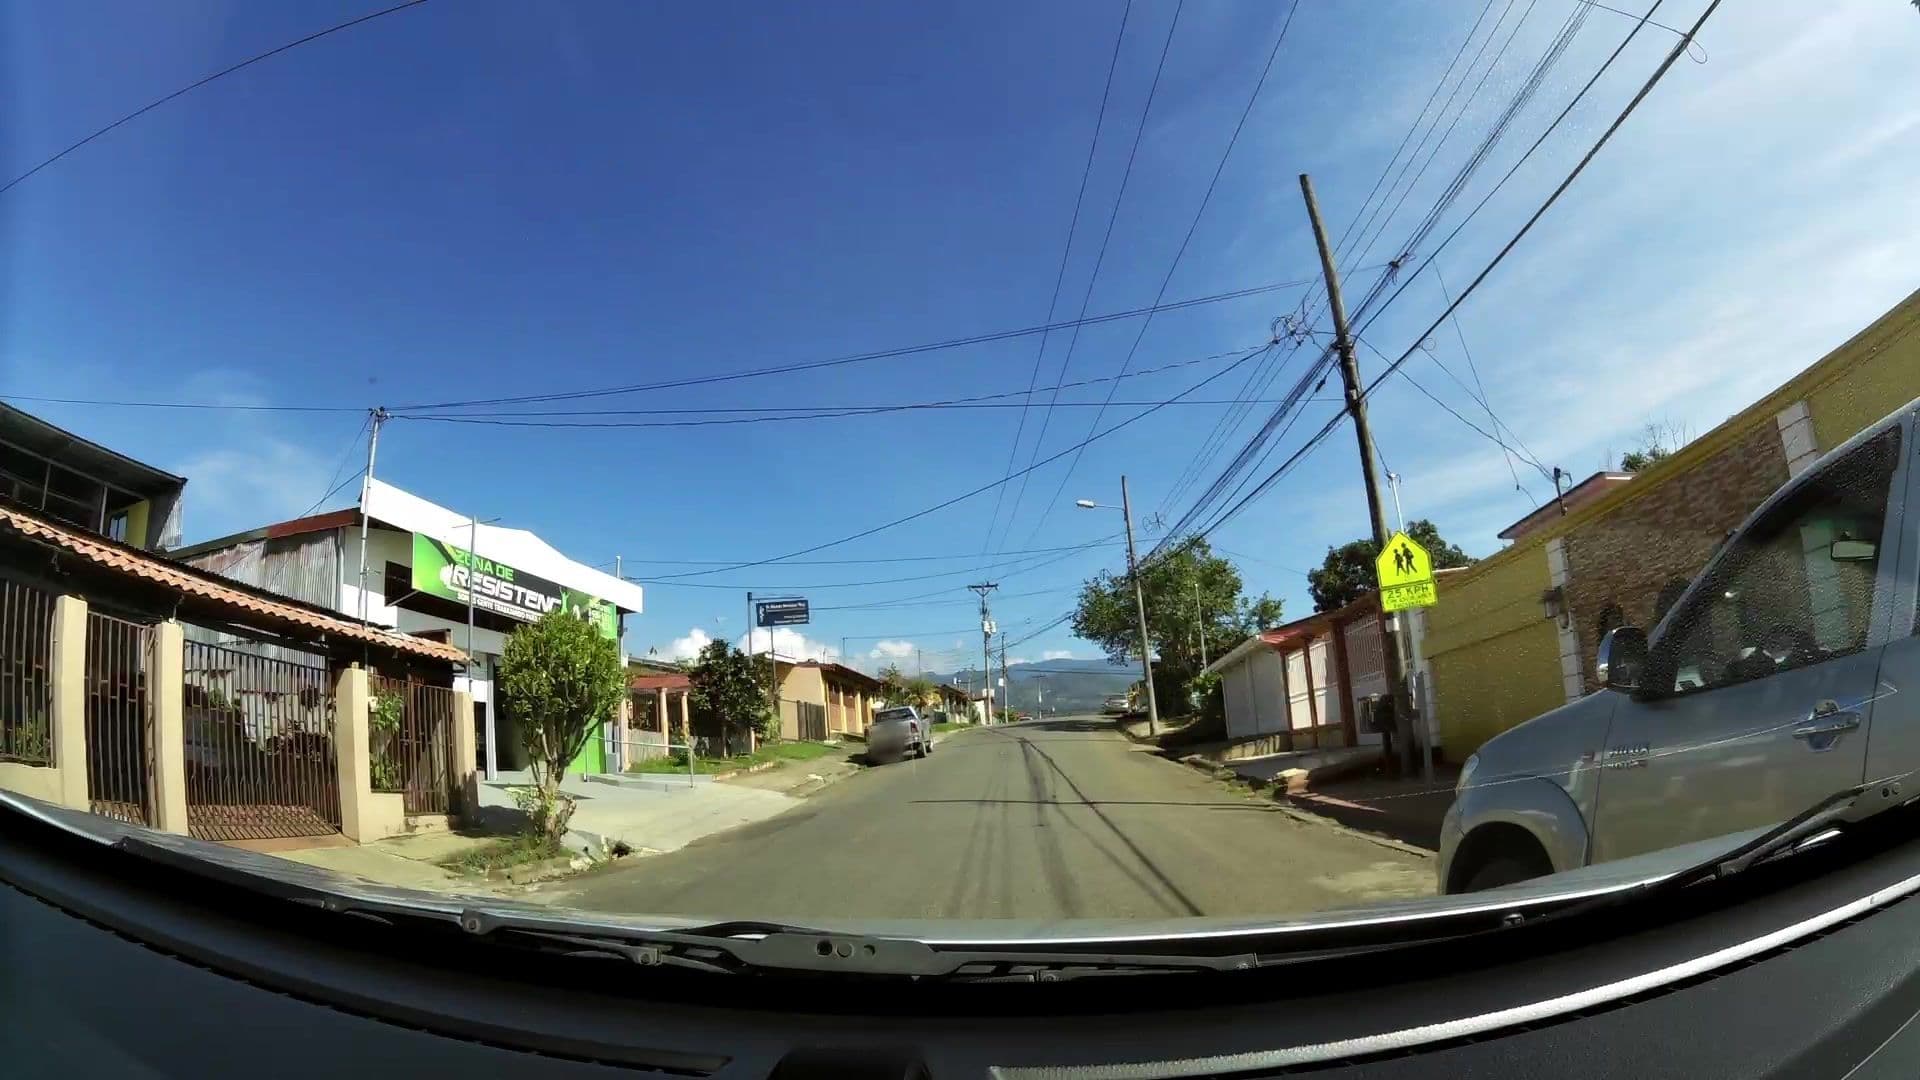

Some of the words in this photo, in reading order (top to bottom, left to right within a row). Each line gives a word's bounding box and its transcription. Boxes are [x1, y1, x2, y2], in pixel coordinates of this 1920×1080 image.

[455, 549, 493, 574] ZONA
[496, 564, 515, 581] DE
[1387, 589, 1402, 599] 25
[1405, 584, 1429, 597] KPH
